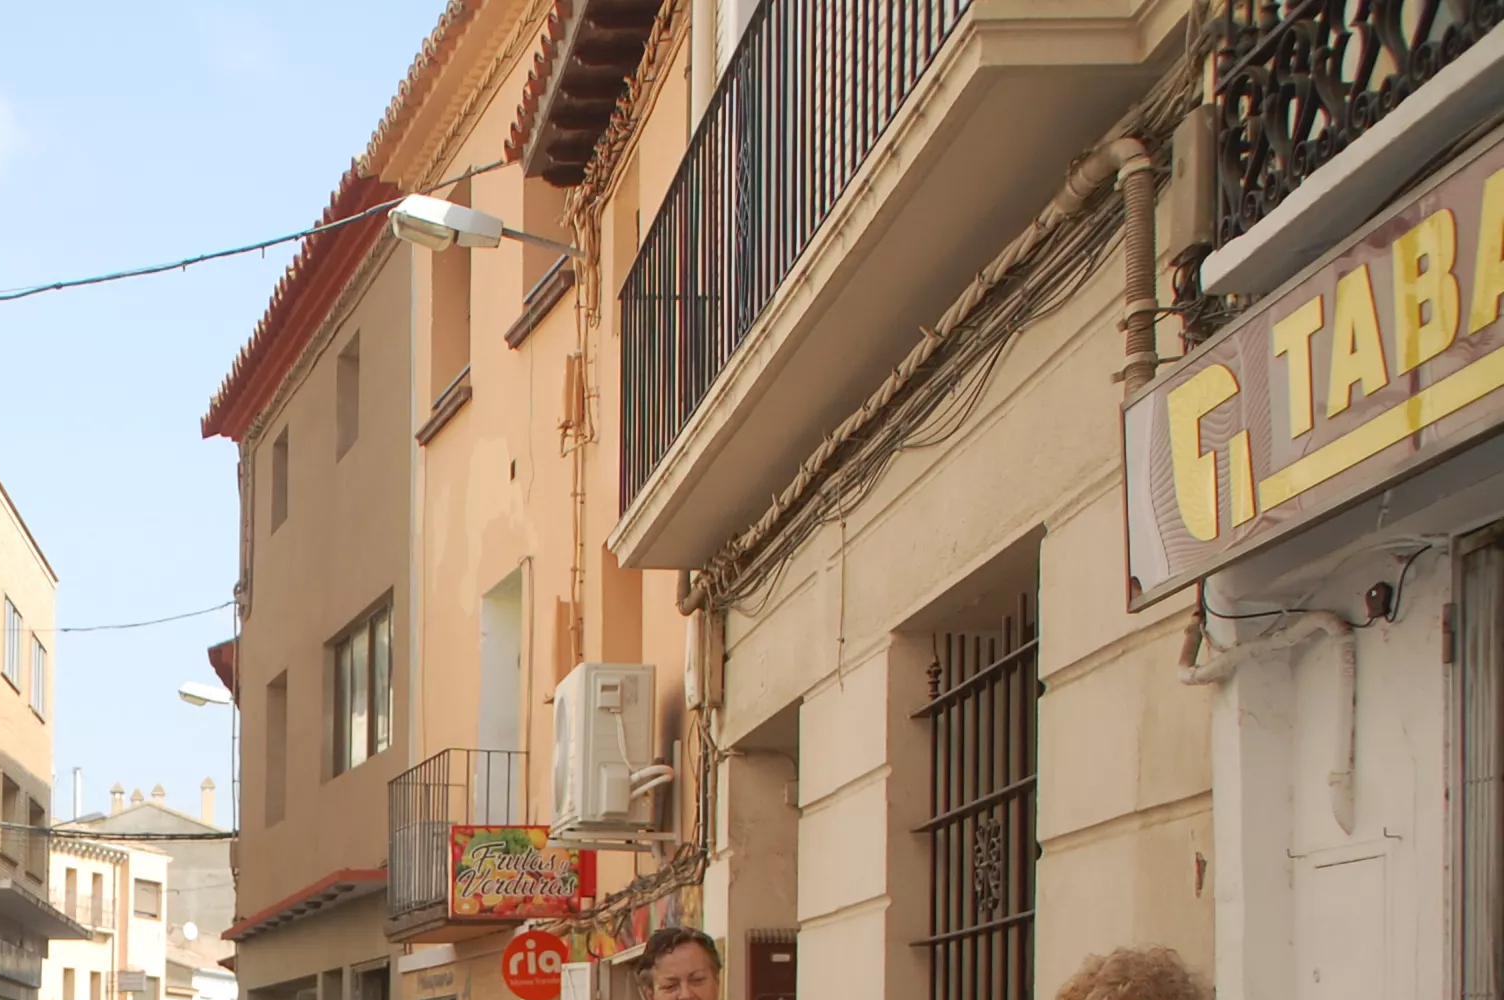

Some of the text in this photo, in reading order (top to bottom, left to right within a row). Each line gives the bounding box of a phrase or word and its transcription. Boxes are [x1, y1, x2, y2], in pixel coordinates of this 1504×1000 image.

[471, 841, 569, 877] Frutas y
[457, 868, 577, 898] Verduras
[509, 938, 562, 975] ria
